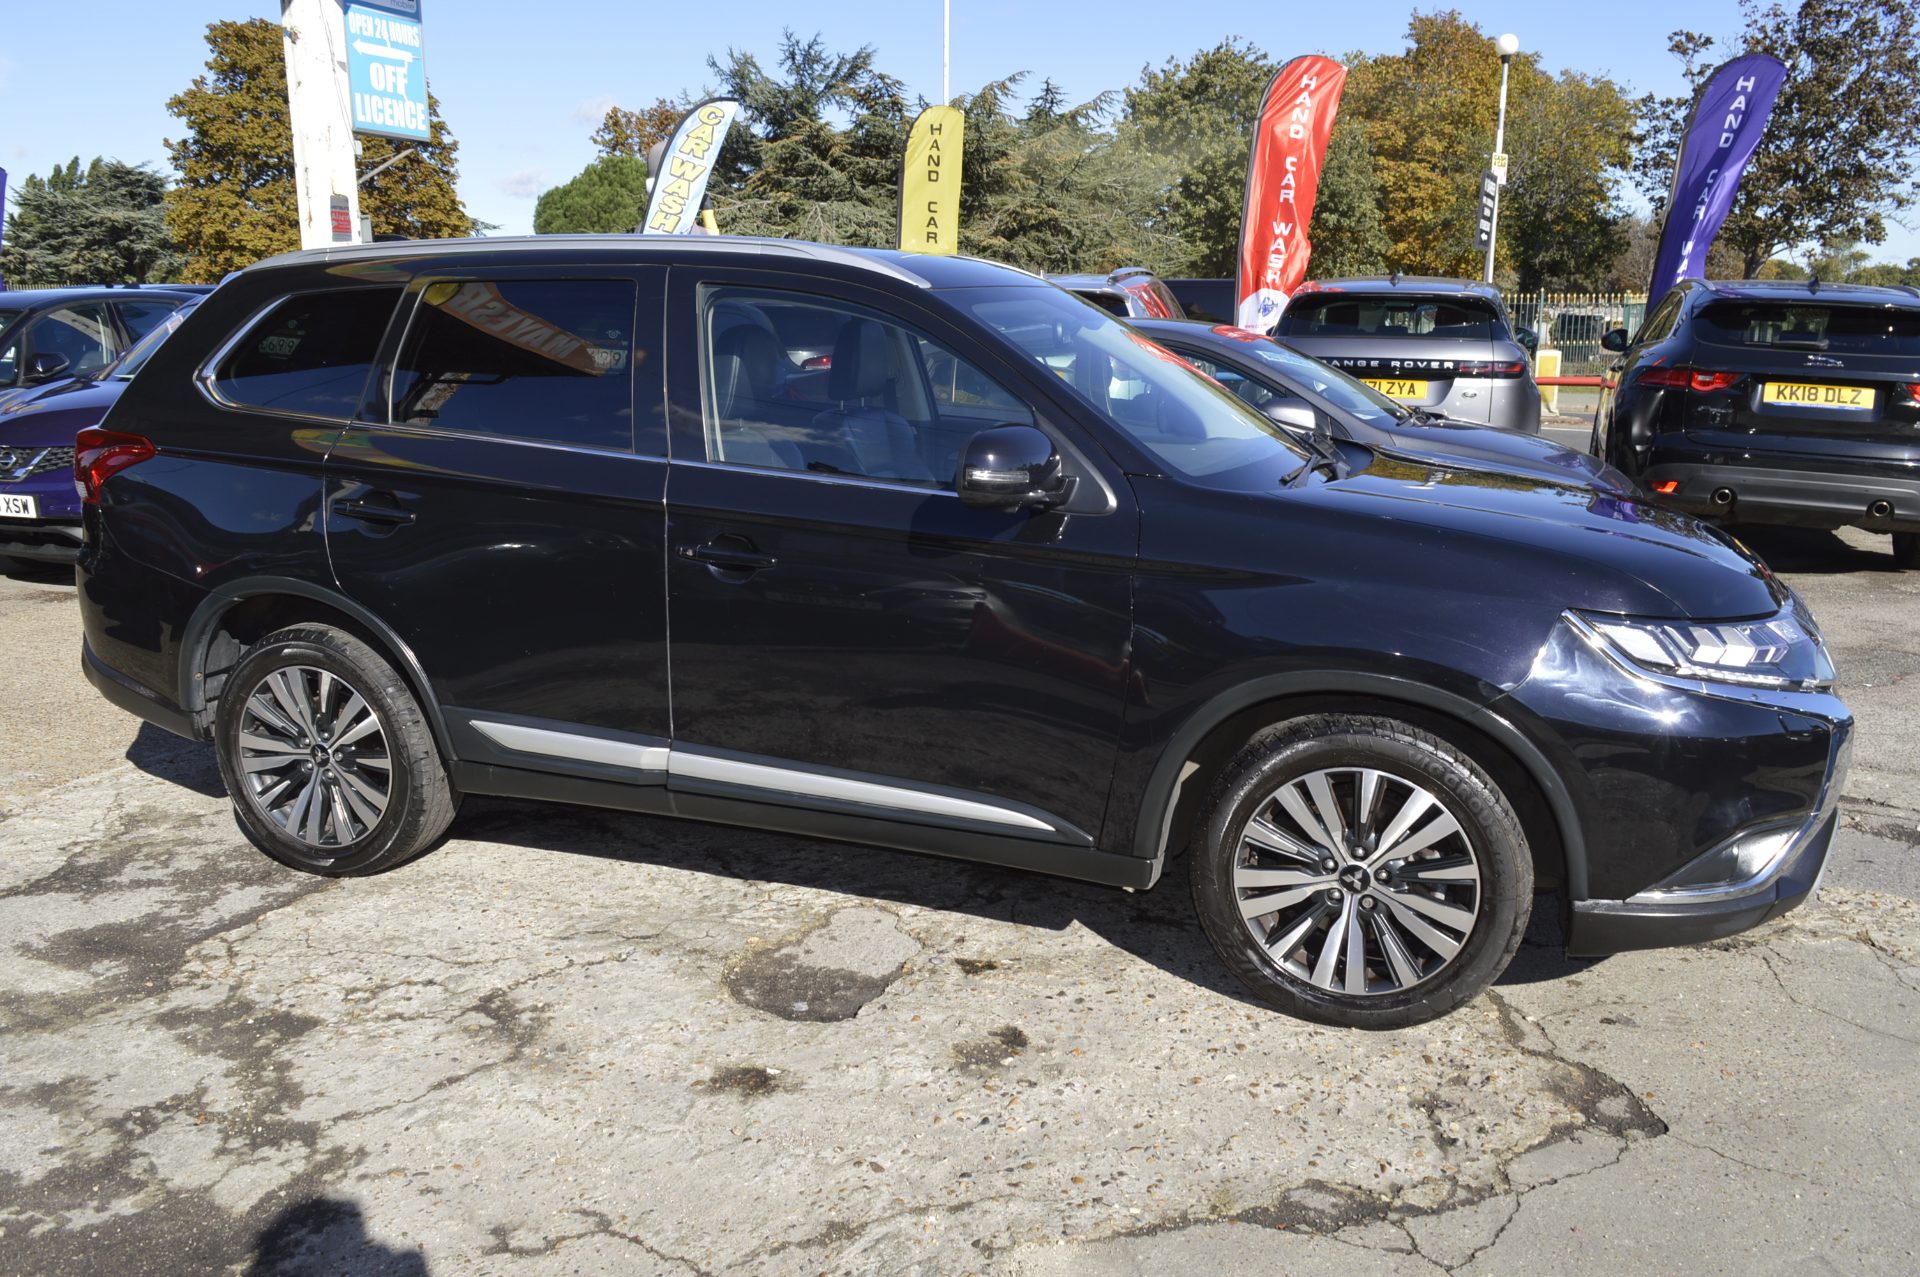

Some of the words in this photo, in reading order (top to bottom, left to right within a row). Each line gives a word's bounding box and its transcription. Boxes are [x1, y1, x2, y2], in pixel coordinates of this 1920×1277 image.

[348, 11, 374, 37] OPEN
[374, 17, 388, 41] 24
[388, 20, 420, 48] HOURS
[369, 62, 408, 95] OFF
[354, 92, 427, 131] LICENCE
[1289, 74, 1317, 139] HAND
[1718, 76, 1755, 148] HAND
[679, 106, 725, 160] CAR
[927, 123, 942, 182] HAND
[649, 156, 707, 233] WASH
[1280, 156, 1298, 203] CAR
[1692, 169, 1718, 220] CAR
[926, 201, 939, 244] CAR
[1266, 221, 1293, 283] WASH
[1390, 360, 1454, 369] ROVER
[1386, 382, 1416, 396] ZYA
[1776, 385, 1819, 401] KK18
[1824, 388, 1861, 405] DLZ
[3, 497, 30, 514] XSW
